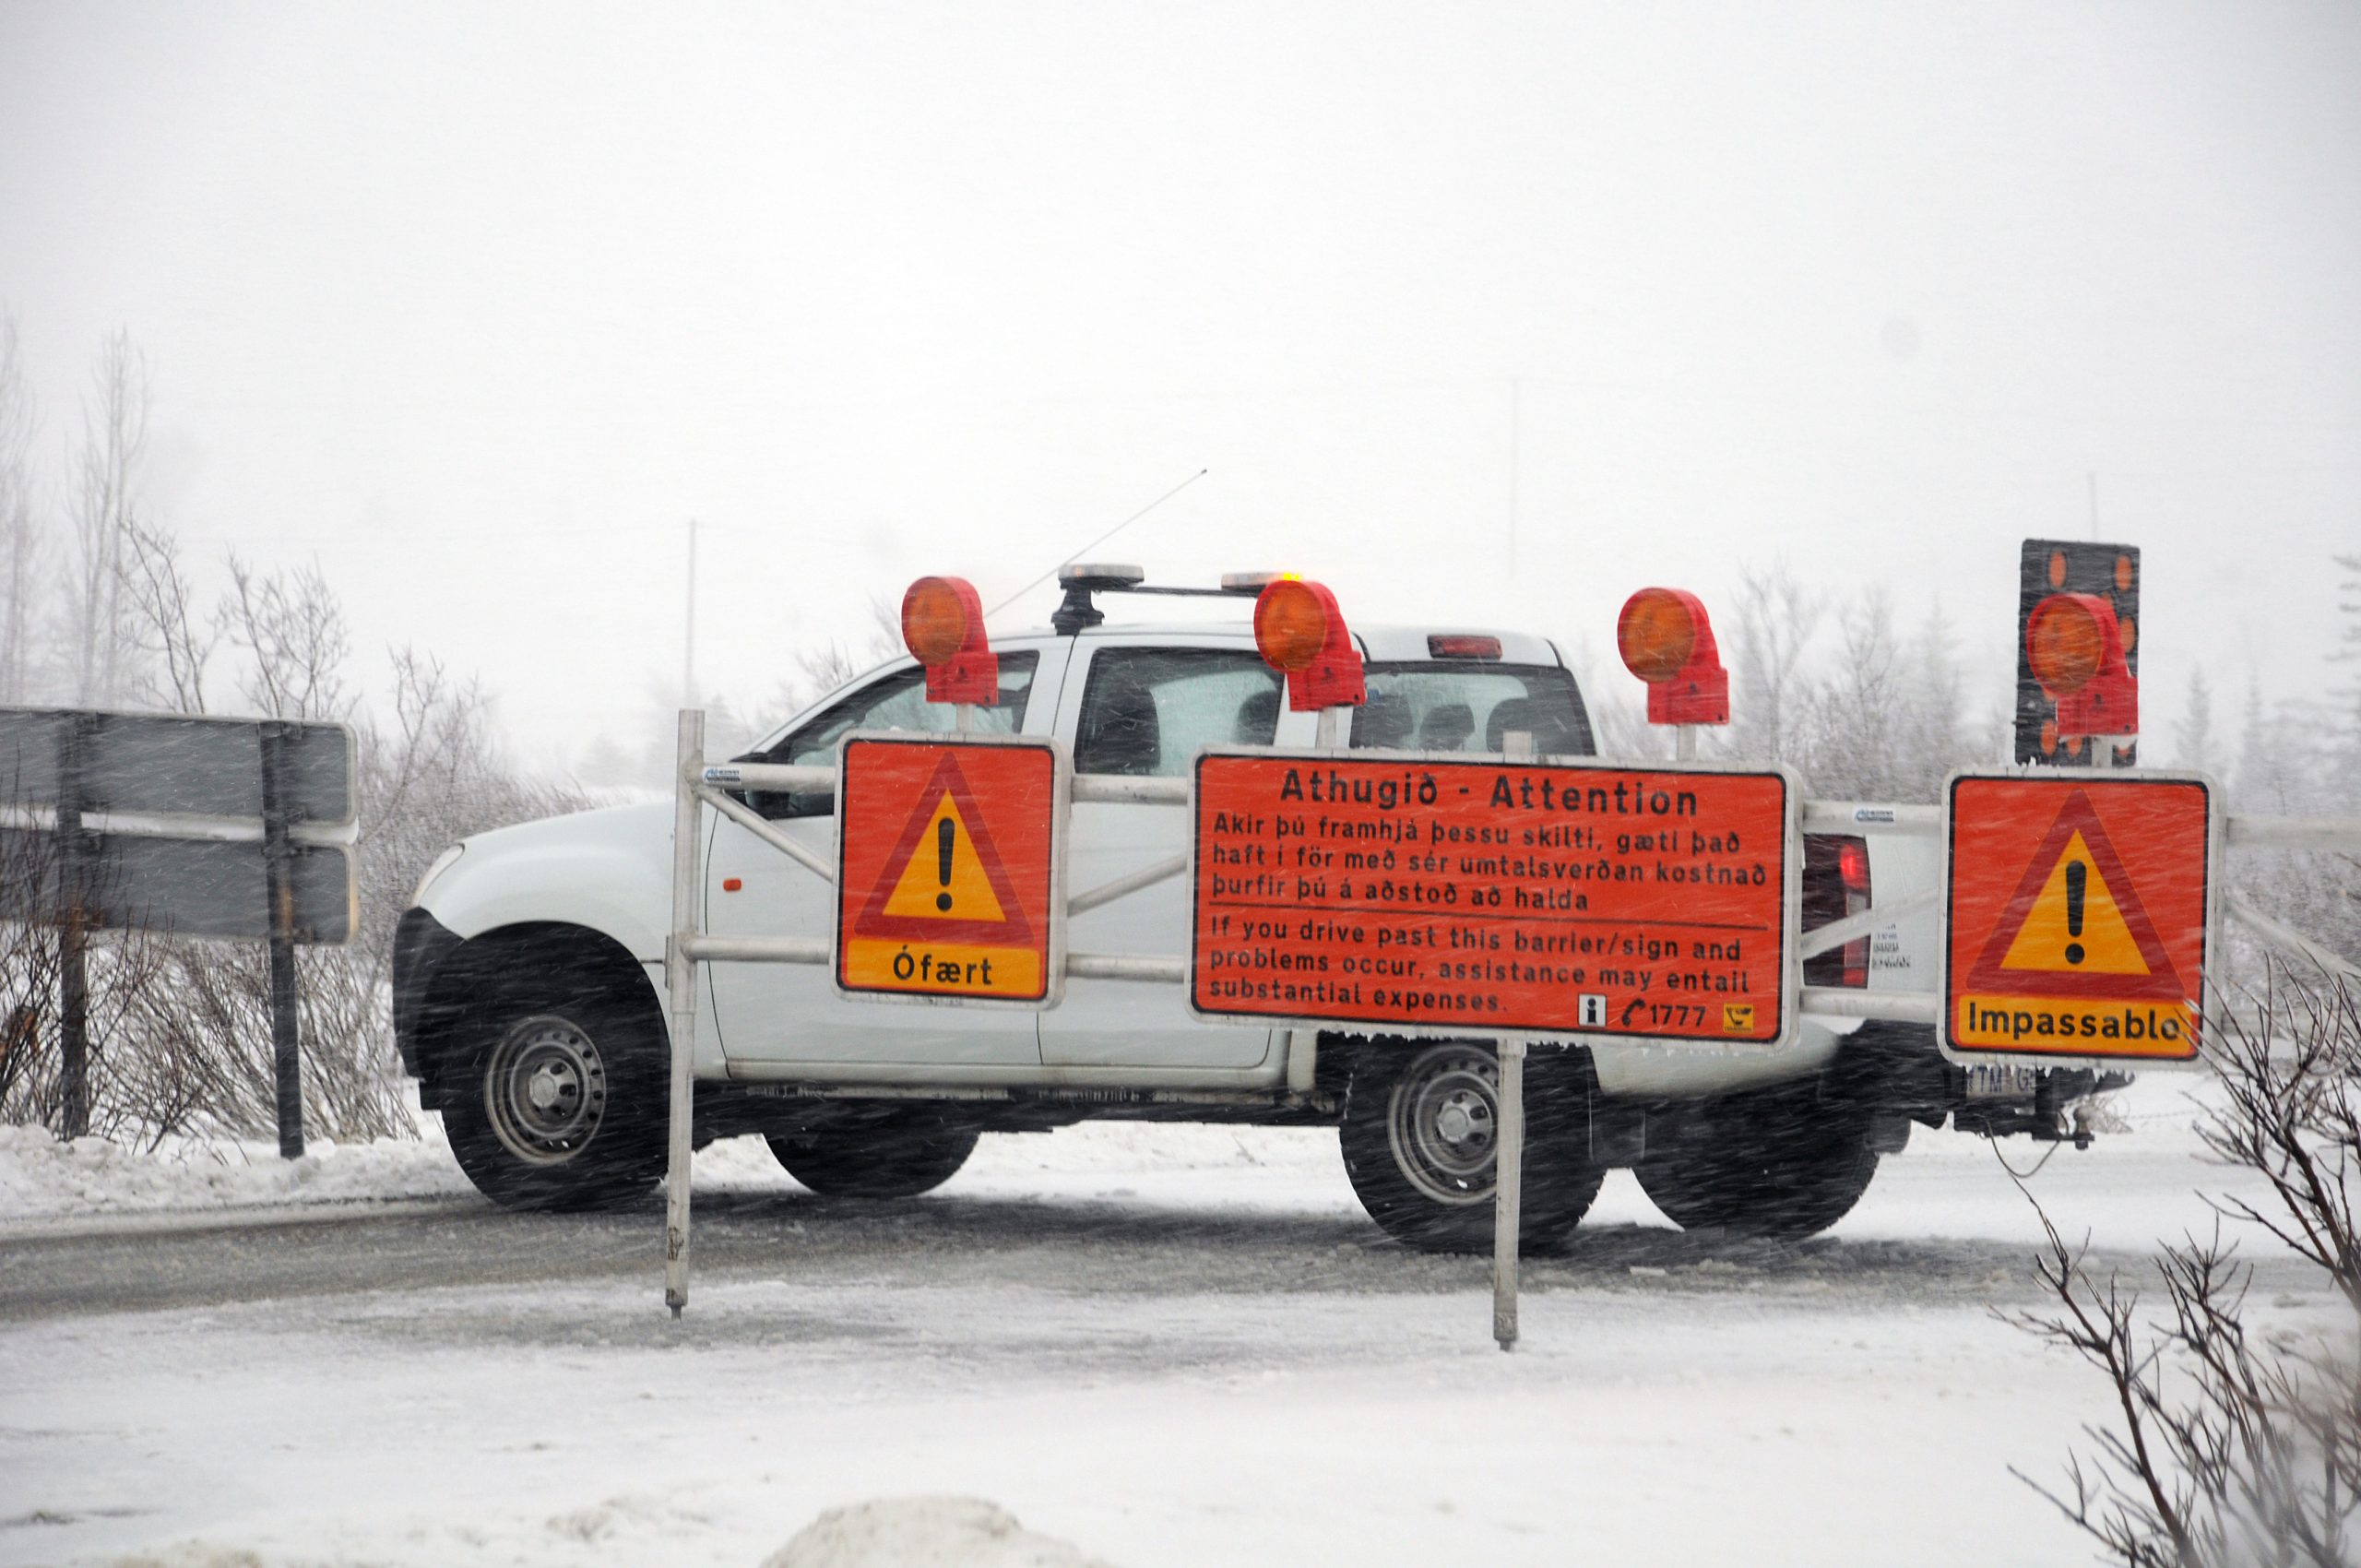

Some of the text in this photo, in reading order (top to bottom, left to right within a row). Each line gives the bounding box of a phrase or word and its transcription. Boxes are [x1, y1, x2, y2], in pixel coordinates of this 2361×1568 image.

[1280, 769, 1438, 809] Athugið
[1489, 775, 1697, 815] Attention
[1214, 813, 1740, 857] Akir þú framhjá þessu skilti, gæti það
[1213, 844, 1765, 885] haft í för með sér umtalsverðan kostnað
[1213, 873, 1587, 910] þurfir þú á aðstoð að halda
[1212, 917, 1740, 961] If you drive past this barrier/sign and
[893, 944, 991, 985] Ófært
[1210, 947, 1749, 992] problems occur, assistance may entail
[1210, 979, 1361, 1004] substantial
[1650, 1004, 1706, 1028] 1777
[1969, 1002, 2180, 1040] Impassable
